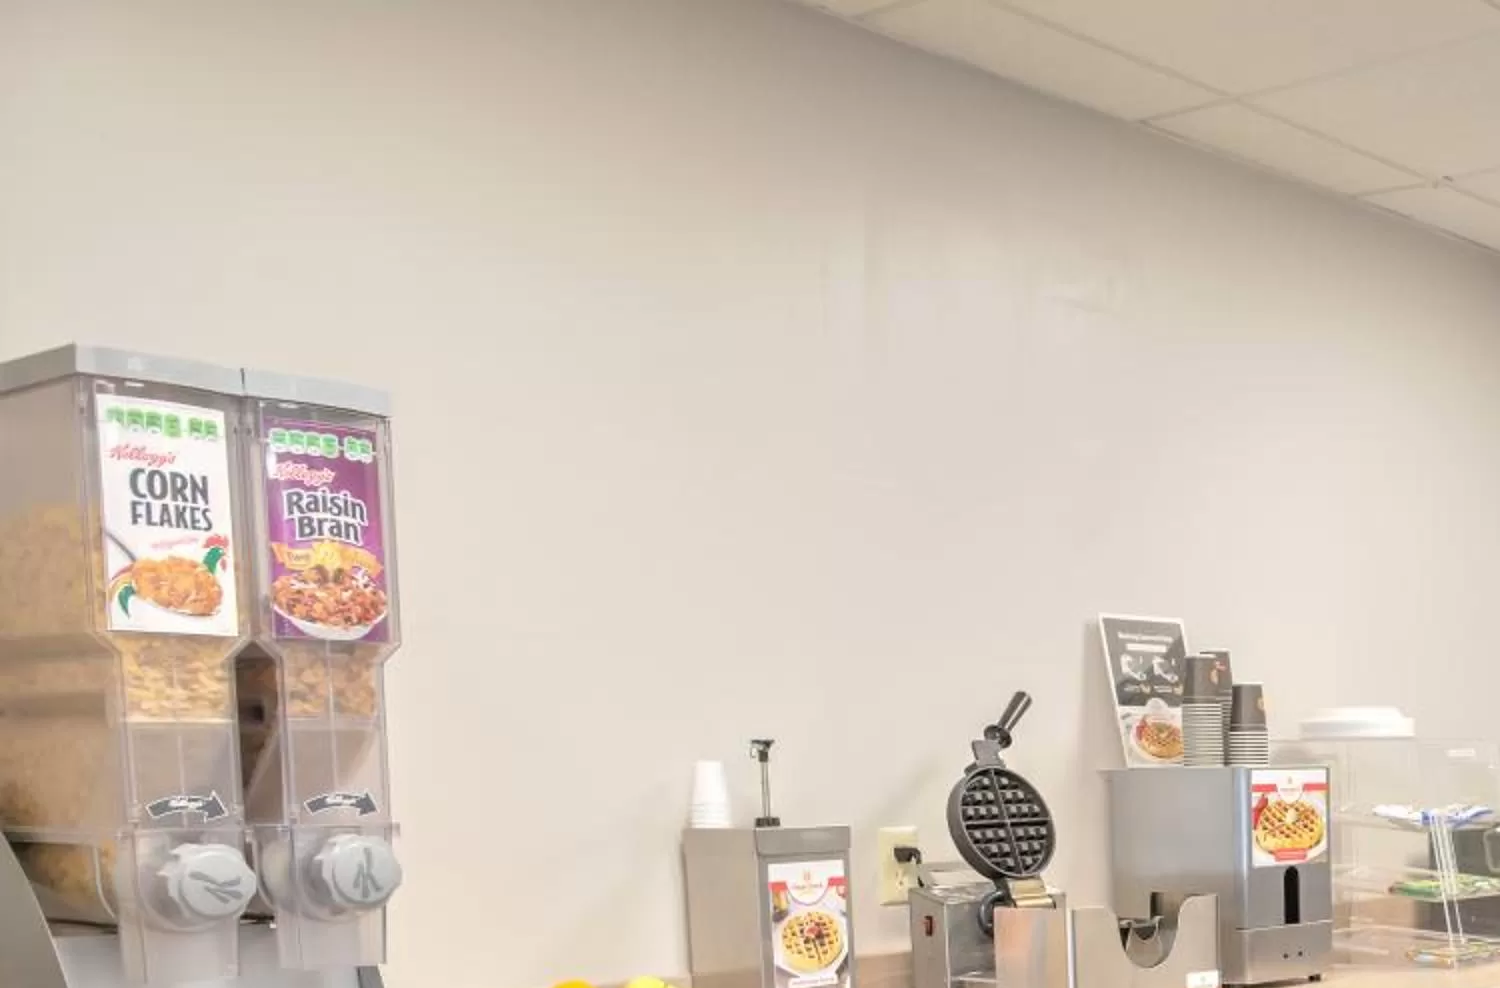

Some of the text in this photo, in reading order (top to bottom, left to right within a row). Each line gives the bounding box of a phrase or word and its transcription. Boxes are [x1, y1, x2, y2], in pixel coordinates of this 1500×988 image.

[129, 467, 209, 505] CORN
[131, 500, 213, 532] FLAKES
[284, 488, 366, 525] Raisin
[297, 515, 360, 543] Bran
